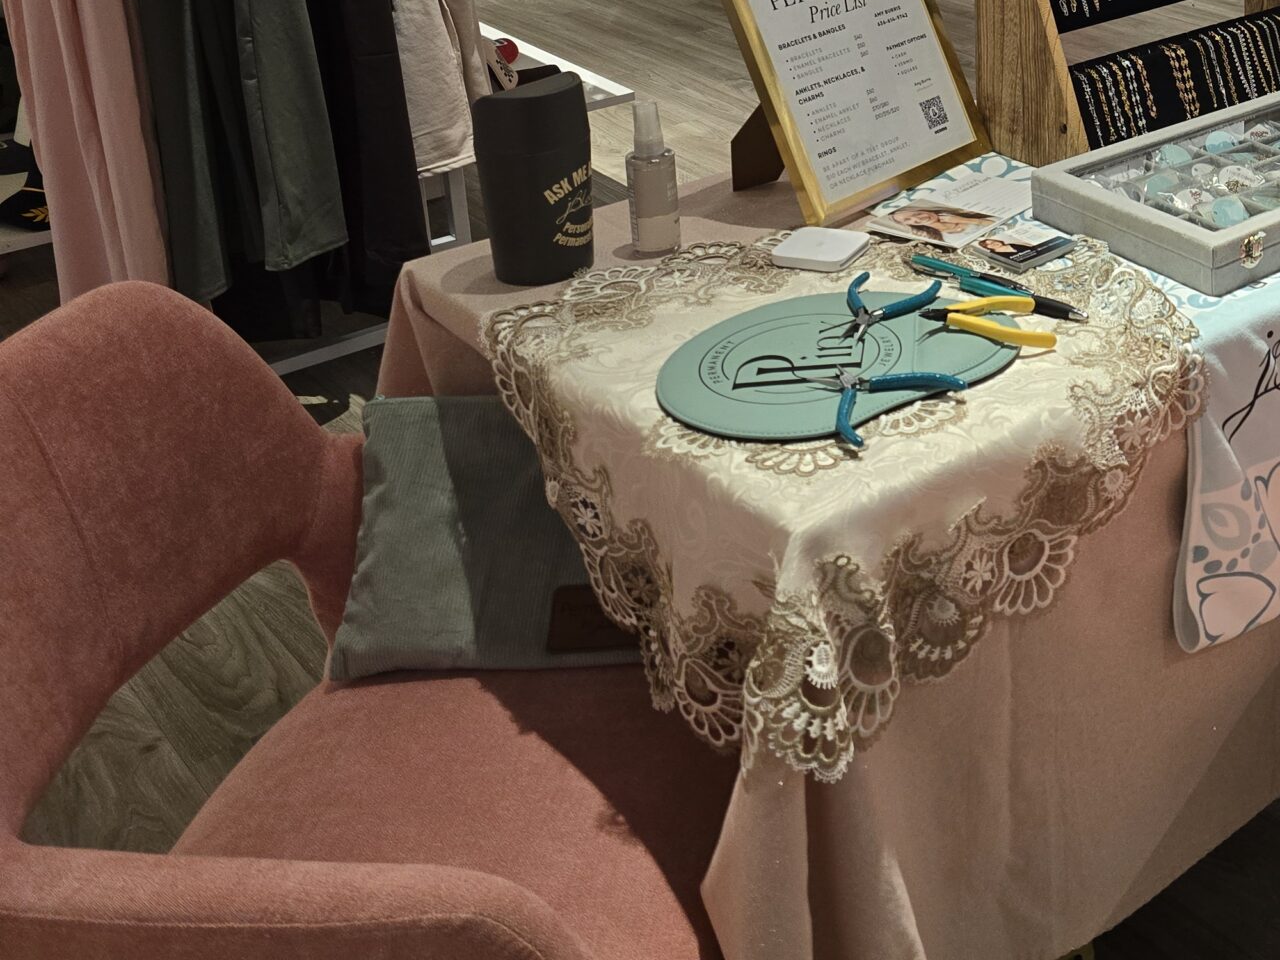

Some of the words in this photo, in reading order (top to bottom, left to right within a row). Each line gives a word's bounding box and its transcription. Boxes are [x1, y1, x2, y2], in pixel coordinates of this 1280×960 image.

[809, 2, 840, 23] Price
[778, 36, 811, 50] BRACELETS
[817, 25, 845, 37] BANGLES
[886, 41, 906, 50] PAYMENT
[907, 34, 926, 43] OPTIONS
[795, 83, 823, 95] ANKLETS,
[823, 69, 860, 85] NECKLACES,
[798, 92, 824, 104] CHARMS
[817, 147, 836, 158] RINGS
[543, 177, 573, 205] ASK
[572, 164, 588, 187] ME
